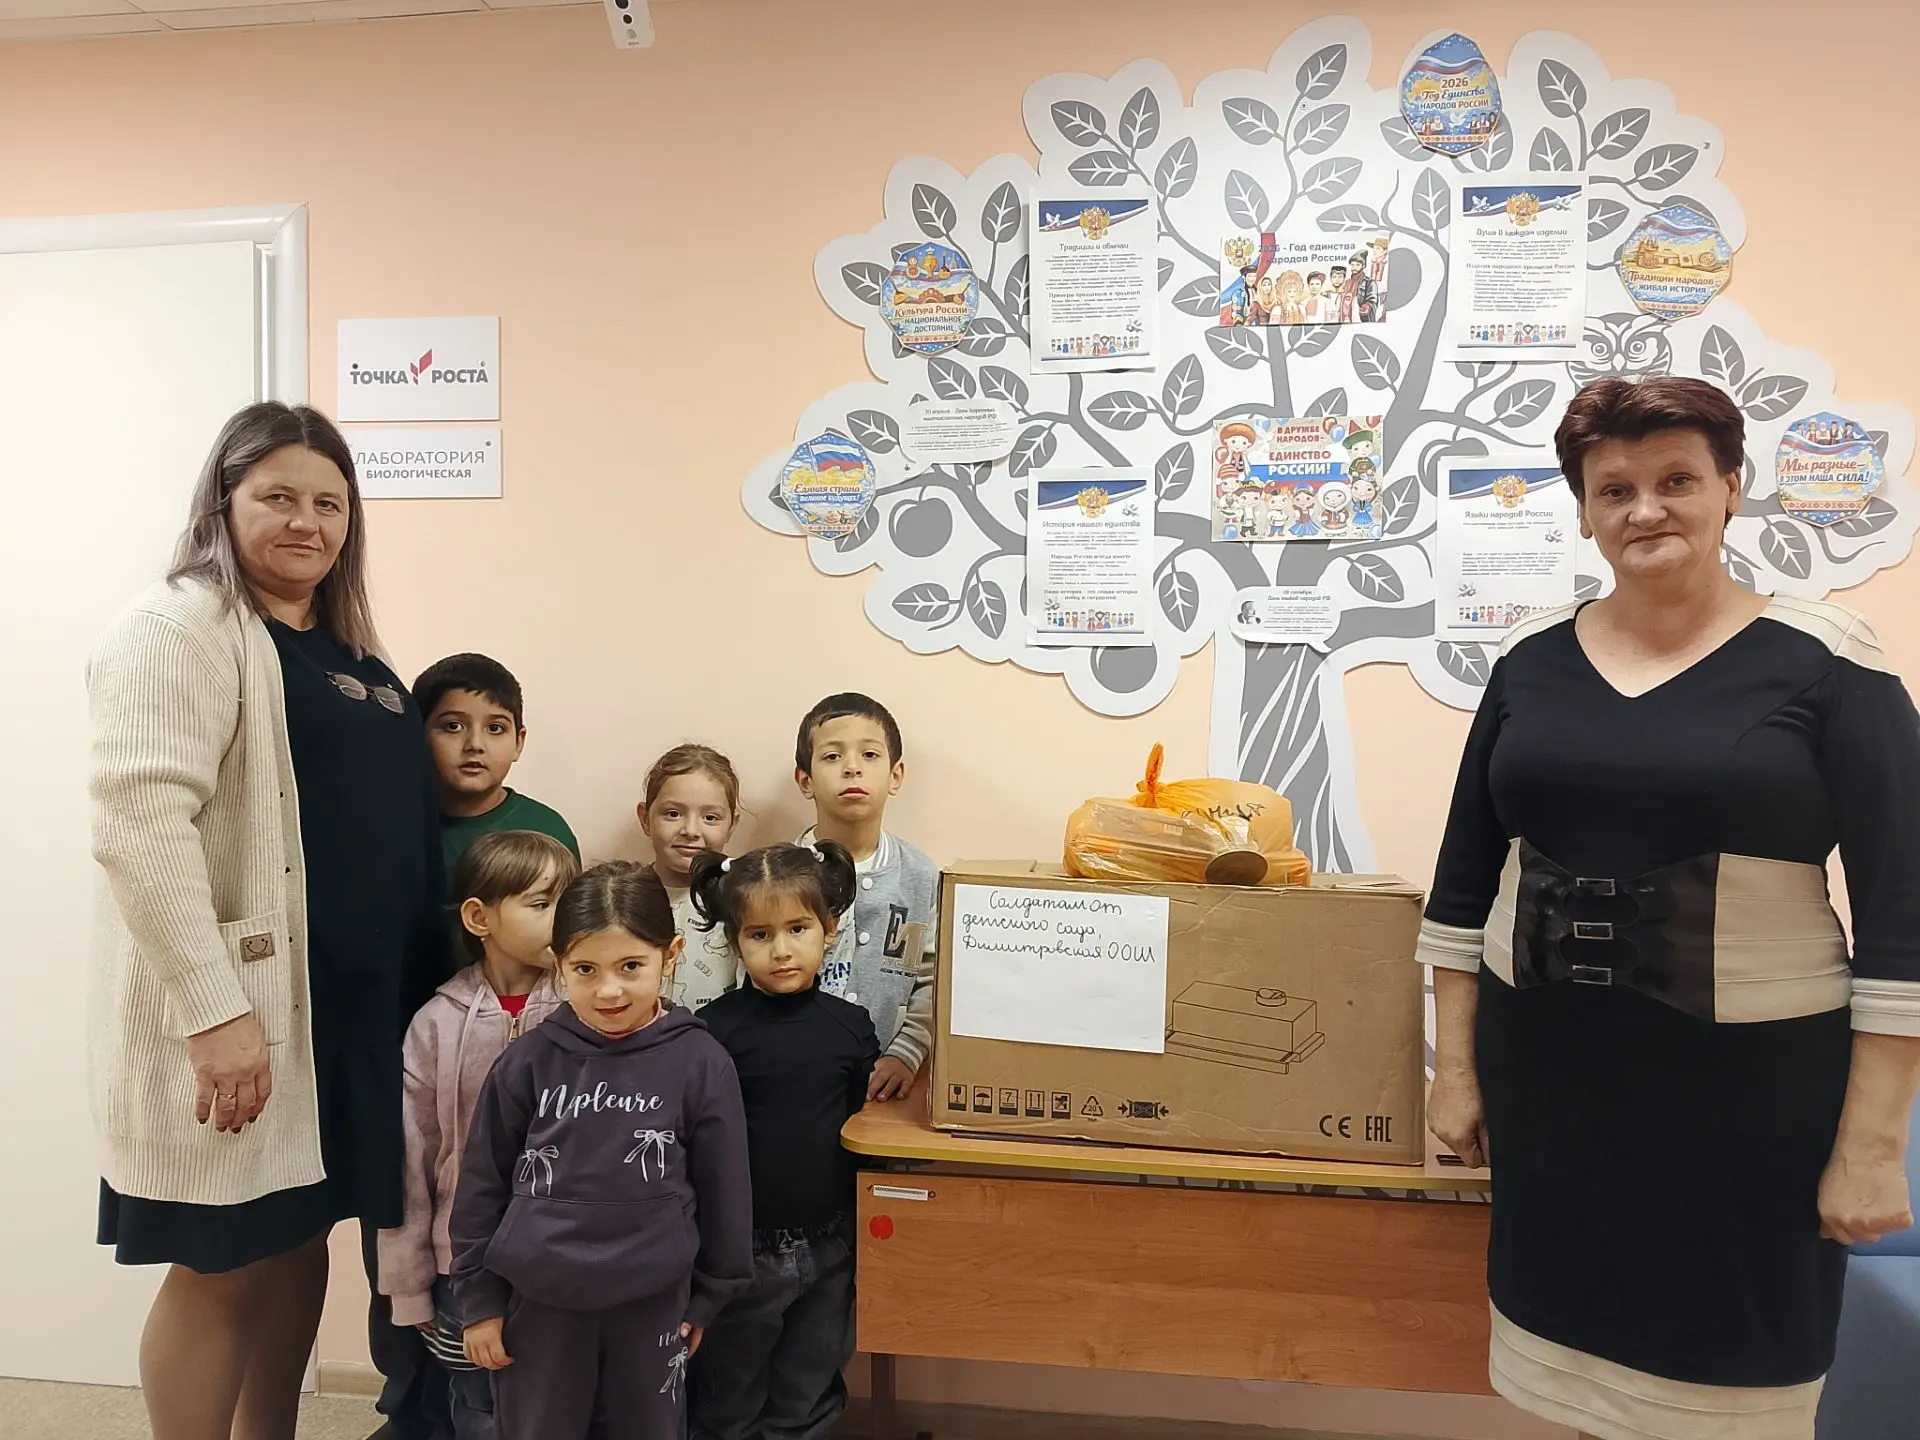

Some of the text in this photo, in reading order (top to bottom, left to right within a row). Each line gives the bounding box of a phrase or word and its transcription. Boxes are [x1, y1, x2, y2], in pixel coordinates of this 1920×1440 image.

[1441, 76, 1469, 88] 2026
[1421, 88, 1485, 101] Год Единства
[1420, 98, 1489, 110] НАРОДОВ РОССИИ
[1258, 243, 1281, 253] 2026
[1289, 243, 1307, 254] Год
[1309, 242, 1356, 251] единства
[1311, 254, 1347, 263] России
[1629, 271, 1674, 283] Традиции
[1638, 284, 1668, 292] ЖИВАЯ
[894, 307, 934, 318] Культура
[904, 316, 962, 325] НАЦИОНАЛЬНОЕ
[913, 325, 954, 333] ДОСТОЯНИЕ
[350, 369, 489, 385] ТОЧКА РОСТА
[1284, 426, 1320, 434] ДРУЖБЕ
[355, 451, 485, 465] ЛАБОРАТОРИЯ
[1269, 450, 1331, 462] ЕДИНСТВО
[1268, 463, 1331, 476] РОССИИ!
[1780, 458, 1809, 472] Мы
[366, 469, 472, 479] БИОЛОГИЧЕСКАЯ
[1785, 475, 1807, 483] ЭТОМ
[1809, 473, 1834, 482] НАША
[1836, 471, 1870, 482] СИЛА!
[793, 483, 860, 494] Единая страна
[962, 913, 1102, 943] детского сада,
[962, 934, 1156, 962] Димитровская ООШ
[538, 1081, 663, 1119] Npleure
